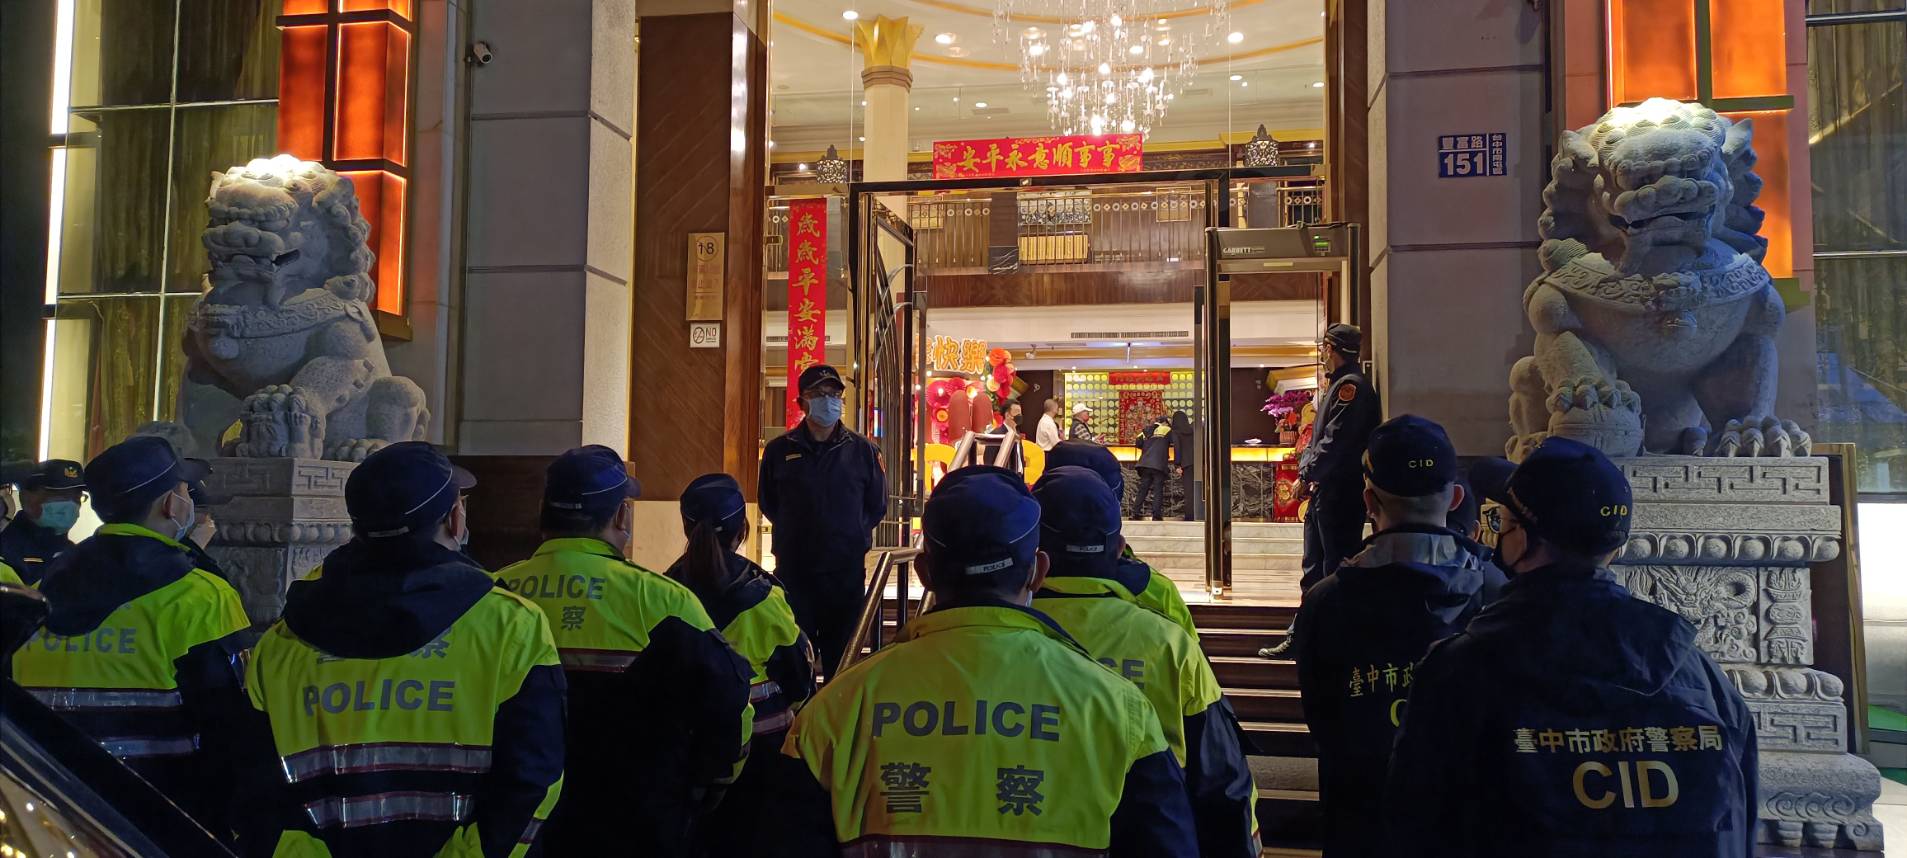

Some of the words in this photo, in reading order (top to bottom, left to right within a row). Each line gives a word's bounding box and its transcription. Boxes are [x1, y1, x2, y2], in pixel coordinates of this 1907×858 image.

[1444, 152, 1483, 175] 151
[705, 327, 717, 337] NO
[927, 335, 987, 374] 快樂
[1408, 458, 1435, 468] CID
[1600, 504, 1628, 517] CID
[561, 605, 586, 631] 察
[303, 679, 455, 717] POLICE
[871, 699, 1061, 742] POLICE
[1512, 725, 1723, 754] 臺中市政府警察局
[1572, 760, 1680, 810] CID
